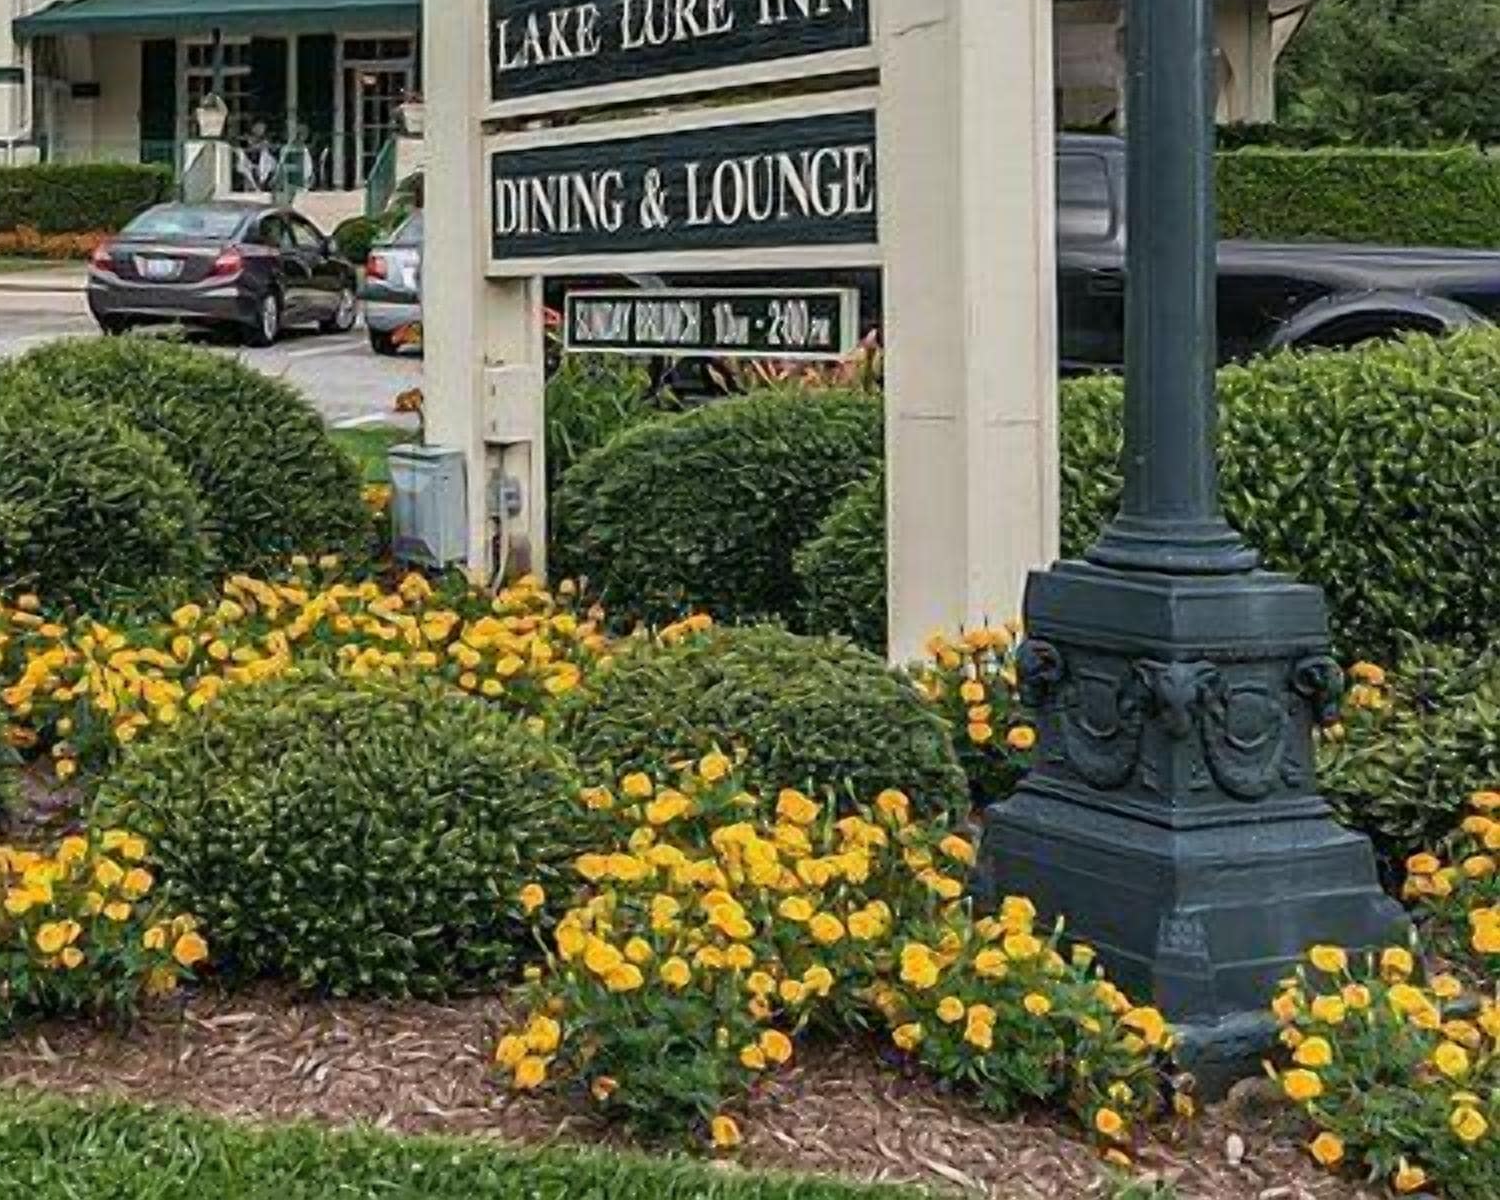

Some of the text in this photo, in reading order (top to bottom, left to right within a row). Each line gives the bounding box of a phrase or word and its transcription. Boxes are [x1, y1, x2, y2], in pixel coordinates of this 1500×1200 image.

[498, 3, 601, 70] LAKE
[496, 144, 874, 234] DINING & LOUNGE
